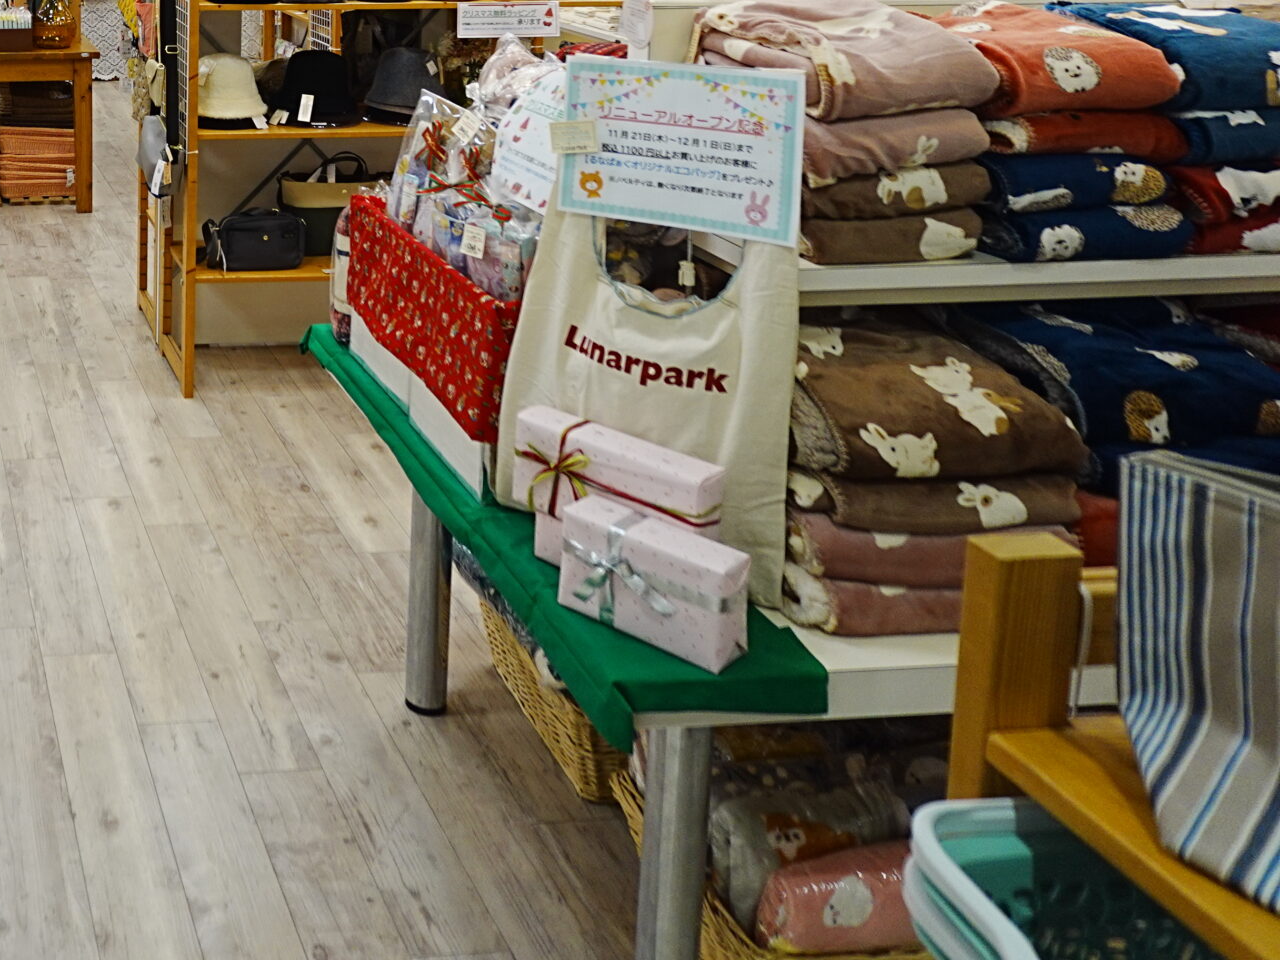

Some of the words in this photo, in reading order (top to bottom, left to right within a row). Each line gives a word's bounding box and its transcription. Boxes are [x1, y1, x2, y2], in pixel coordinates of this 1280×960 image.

[598, 106, 766, 136] リニューアルオープン記念
[564, 324, 729, 393] Lunarpark
